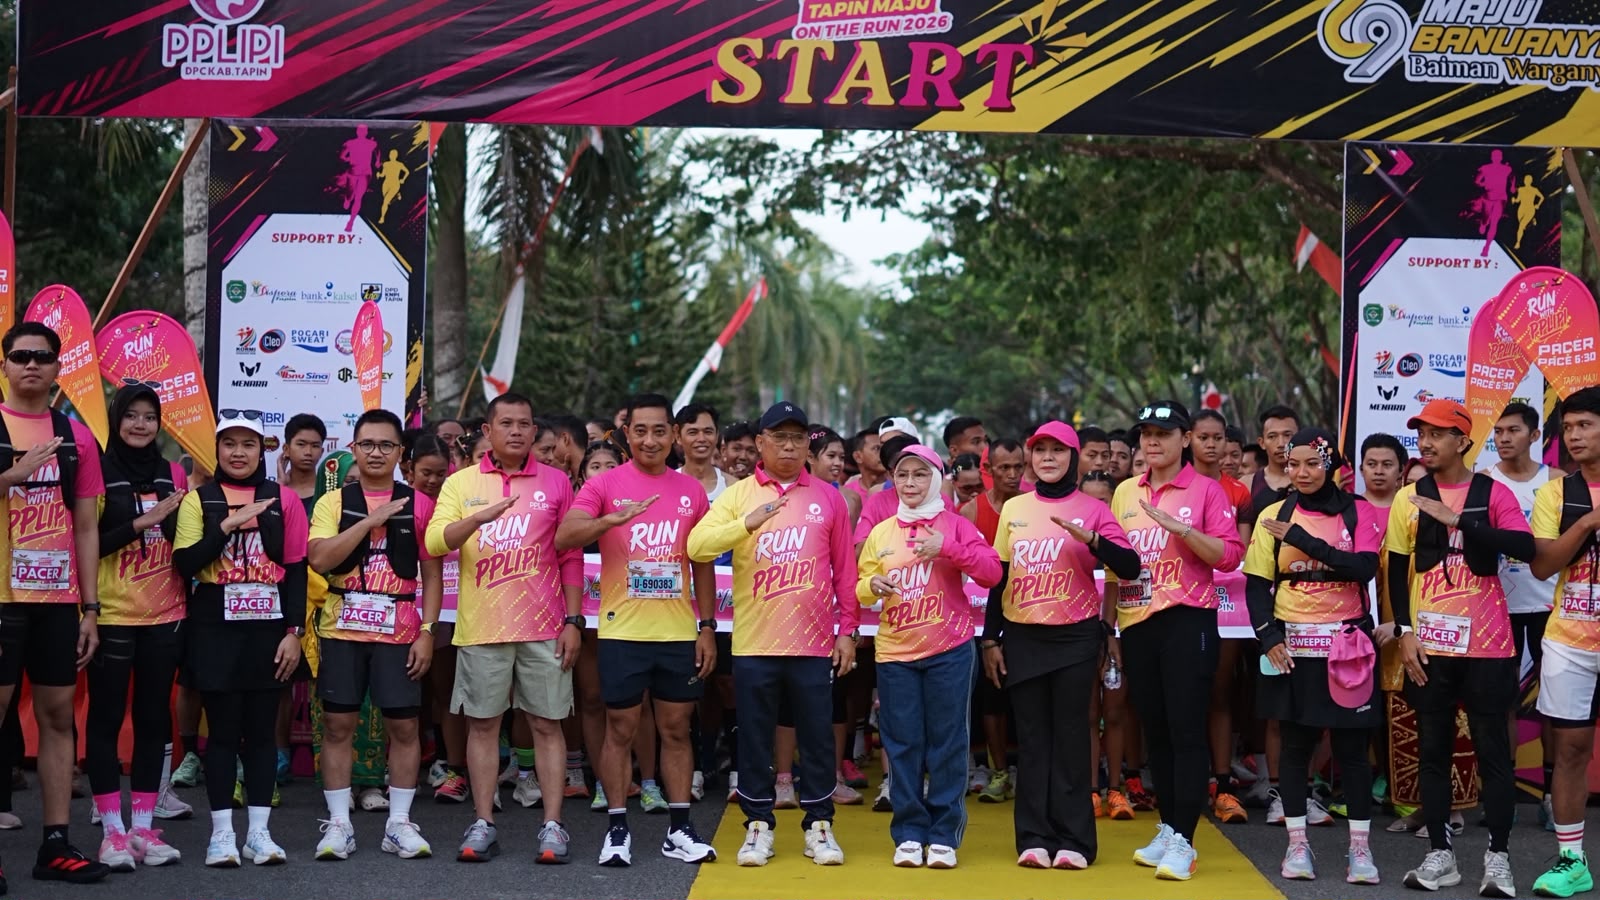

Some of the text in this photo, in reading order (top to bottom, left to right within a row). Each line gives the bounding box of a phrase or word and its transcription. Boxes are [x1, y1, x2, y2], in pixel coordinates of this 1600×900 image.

[809, 0, 932, 19] TAPIN MAJU
[1425, 0, 1530, 25] MAJU
[795, 16, 949, 39] ON THE RUN 2026
[166, 26, 283, 65] PPLIPI
[707, 37, 1037, 111] START
[1409, 54, 1499, 79] Baiman
[272, 233, 335, 244] SUPPORT
[338, 233, 355, 244] BY
[1408, 257, 1471, 268] SUPPORT
[1474, 258, 1492, 269] BY
[301, 290, 323, 300] bank
[1527, 290, 1556, 317] RUN
[1438, 315, 1460, 325] bank
[1528, 307, 1569, 341] PPLIPI
[291, 329, 329, 337] POCARI
[123, 332, 154, 360] RUN
[264, 335, 281, 347] Cleo
[1538, 337, 1594, 356] PACER
[1429, 353, 1466, 361] POCARI
[1538, 351, 1597, 367] PACE 6:30
[1402, 359, 1418, 371] Cleo
[1472, 363, 1515, 380] PACER
[231, 380, 268, 388] MENARA
[1470, 376, 1515, 391] PACE 6:30
[178, 384, 200, 399] 7:30
[1369, 403, 1406, 411] MENARA
[27, 491, 54, 505] WITH
[805, 513, 825, 522] PPLIPI
[478, 513, 532, 551] RUN
[630, 519, 680, 553] RUN
[495, 539, 522, 553] WITH
[647, 545, 672, 557] WITH
[756, 526, 808, 563] RUN
[772, 550, 798, 565] WITH
[1012, 538, 1065, 569] RUN
[18, 567, 60, 580] PACER
[476, 544, 541, 589] PPLIPI
[1027, 562, 1054, 575] WITH
[634, 579, 673, 589] U-690383
[753, 557, 817, 600] PPLIPI
[901, 588, 925, 601] WITH
[1011, 569, 1075, 605] PPLIPI
[230, 598, 271, 611] PACER
[886, 591, 944, 629] PPLIPI
[343, 609, 383, 623] PACER
[1290, 636, 1333, 647] SWEEPER
[1420, 627, 1456, 643] PACER
